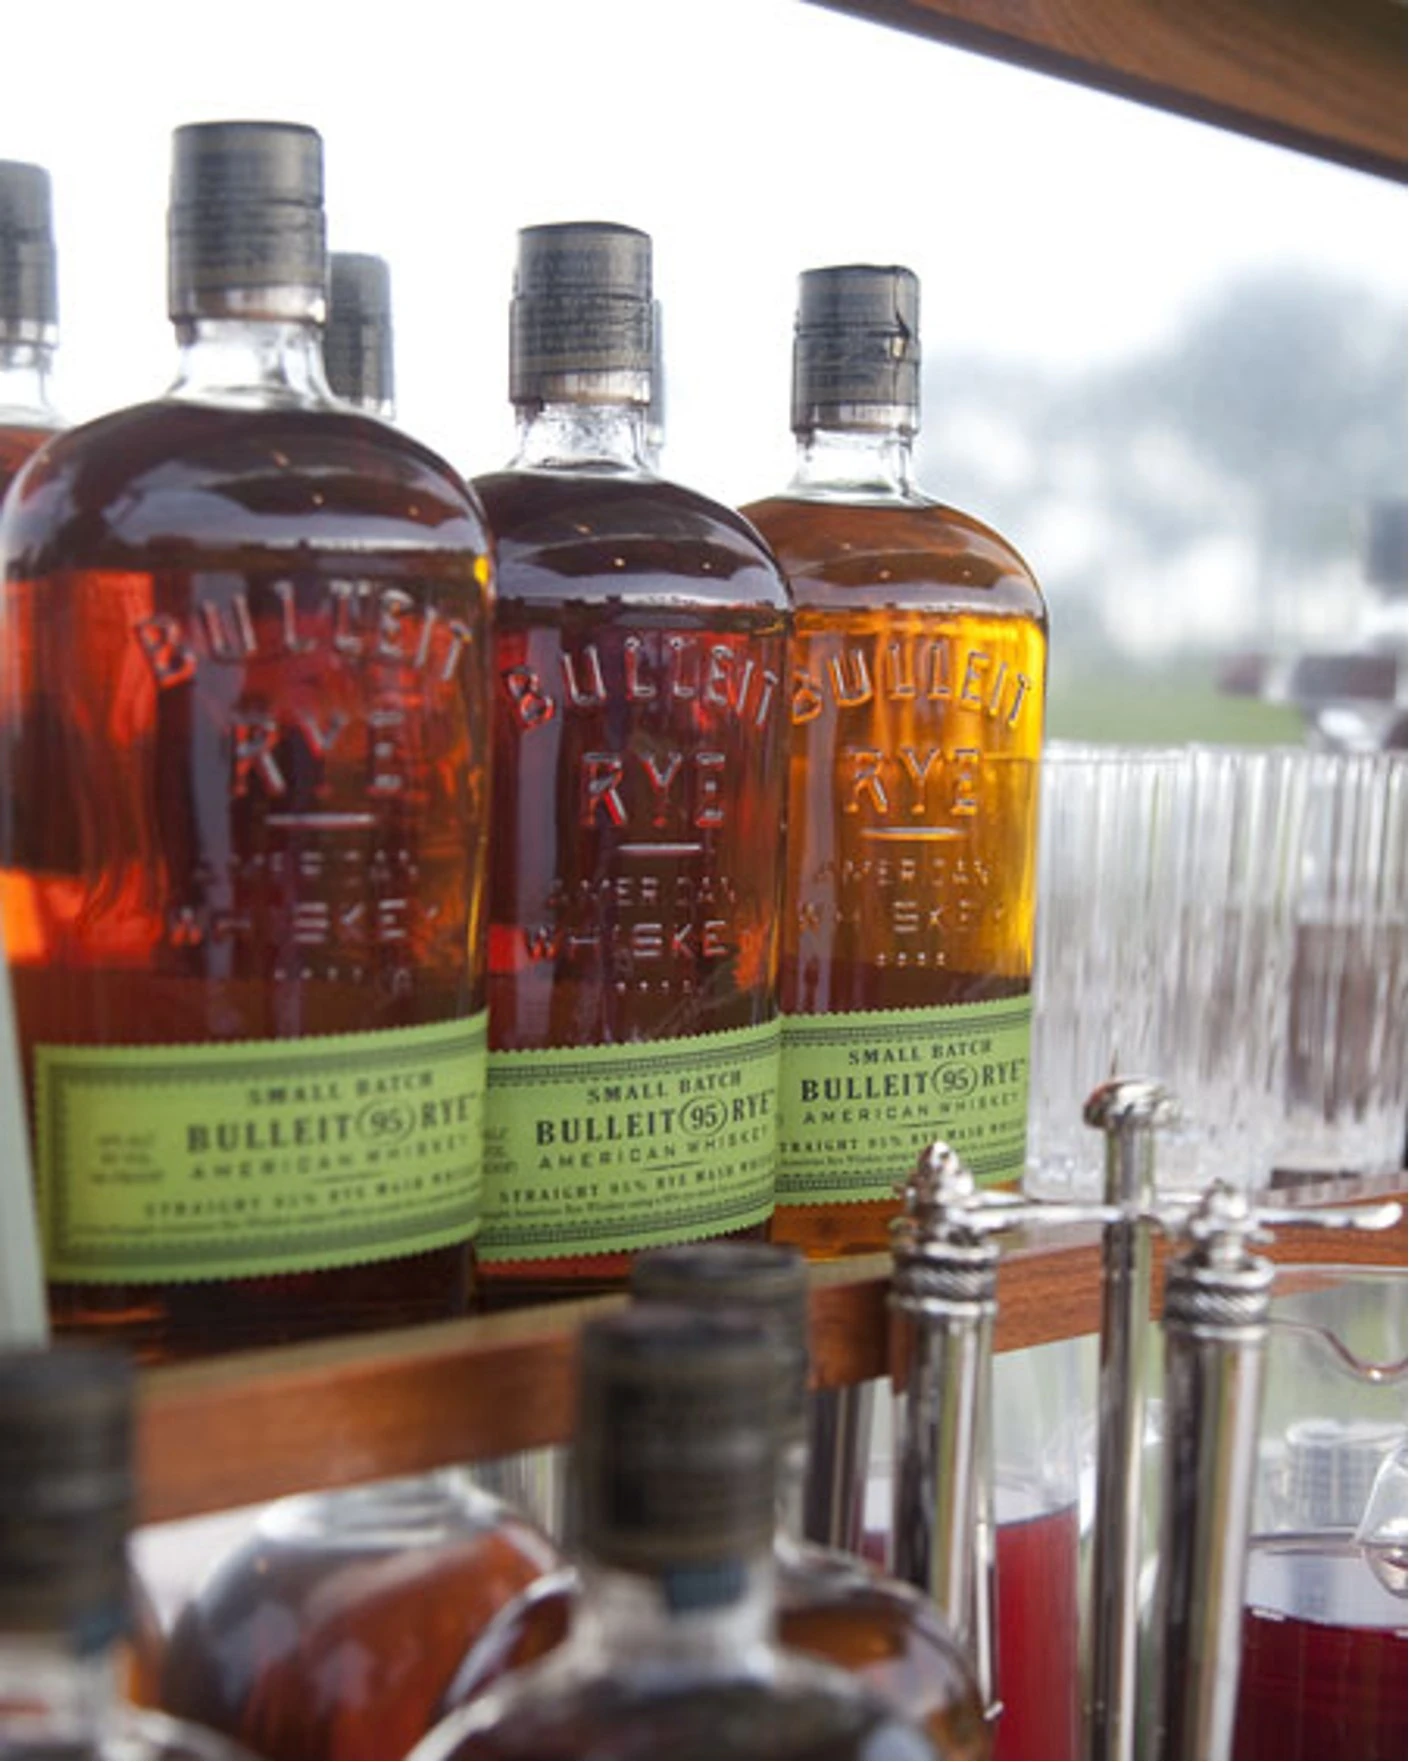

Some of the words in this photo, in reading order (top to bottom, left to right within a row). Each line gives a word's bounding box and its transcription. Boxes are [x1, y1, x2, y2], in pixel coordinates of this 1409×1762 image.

[139, 579, 472, 689] BULLEIT
[507, 635, 778, 730] BULLEIT
[792, 641, 1031, 728] BULLEIT
[232, 711, 404, 796] RYE
[580, 751, 727, 828] RYE
[844, 748, 980, 816] RYE
[546, 874, 736, 907] AMERCAN
[169, 899, 440, 946] WHSKE
[525, 918, 756, 963] WHISKE
[848, 1046, 921, 1066] SMALL
[931, 1038, 993, 1060] BATCH
[248, 1081, 340, 1106] SMALL
[355, 1069, 434, 1097] BATCH
[587, 1082, 667, 1104] SMALL
[680, 1069, 741, 1094] BATCH
[801, 1072, 930, 1102] BULLEIT
[941, 1067, 970, 1091] 95
[186, 1113, 352, 1154] BULLEIT
[369, 1106, 404, 1136] 95
[536, 1107, 676, 1146] BULLEIT
[689, 1103, 719, 1131] 95
[803, 1104, 930, 1125] AMERICAN
[940, 1091, 1019, 1115] WHISKEY
[188, 1152, 356, 1181] AMERICAN
[539, 1142, 676, 1170] AMERICAN
[687, 1123, 768, 1153] WHISKEY
[779, 1137, 858, 1153] TRAIGHT
